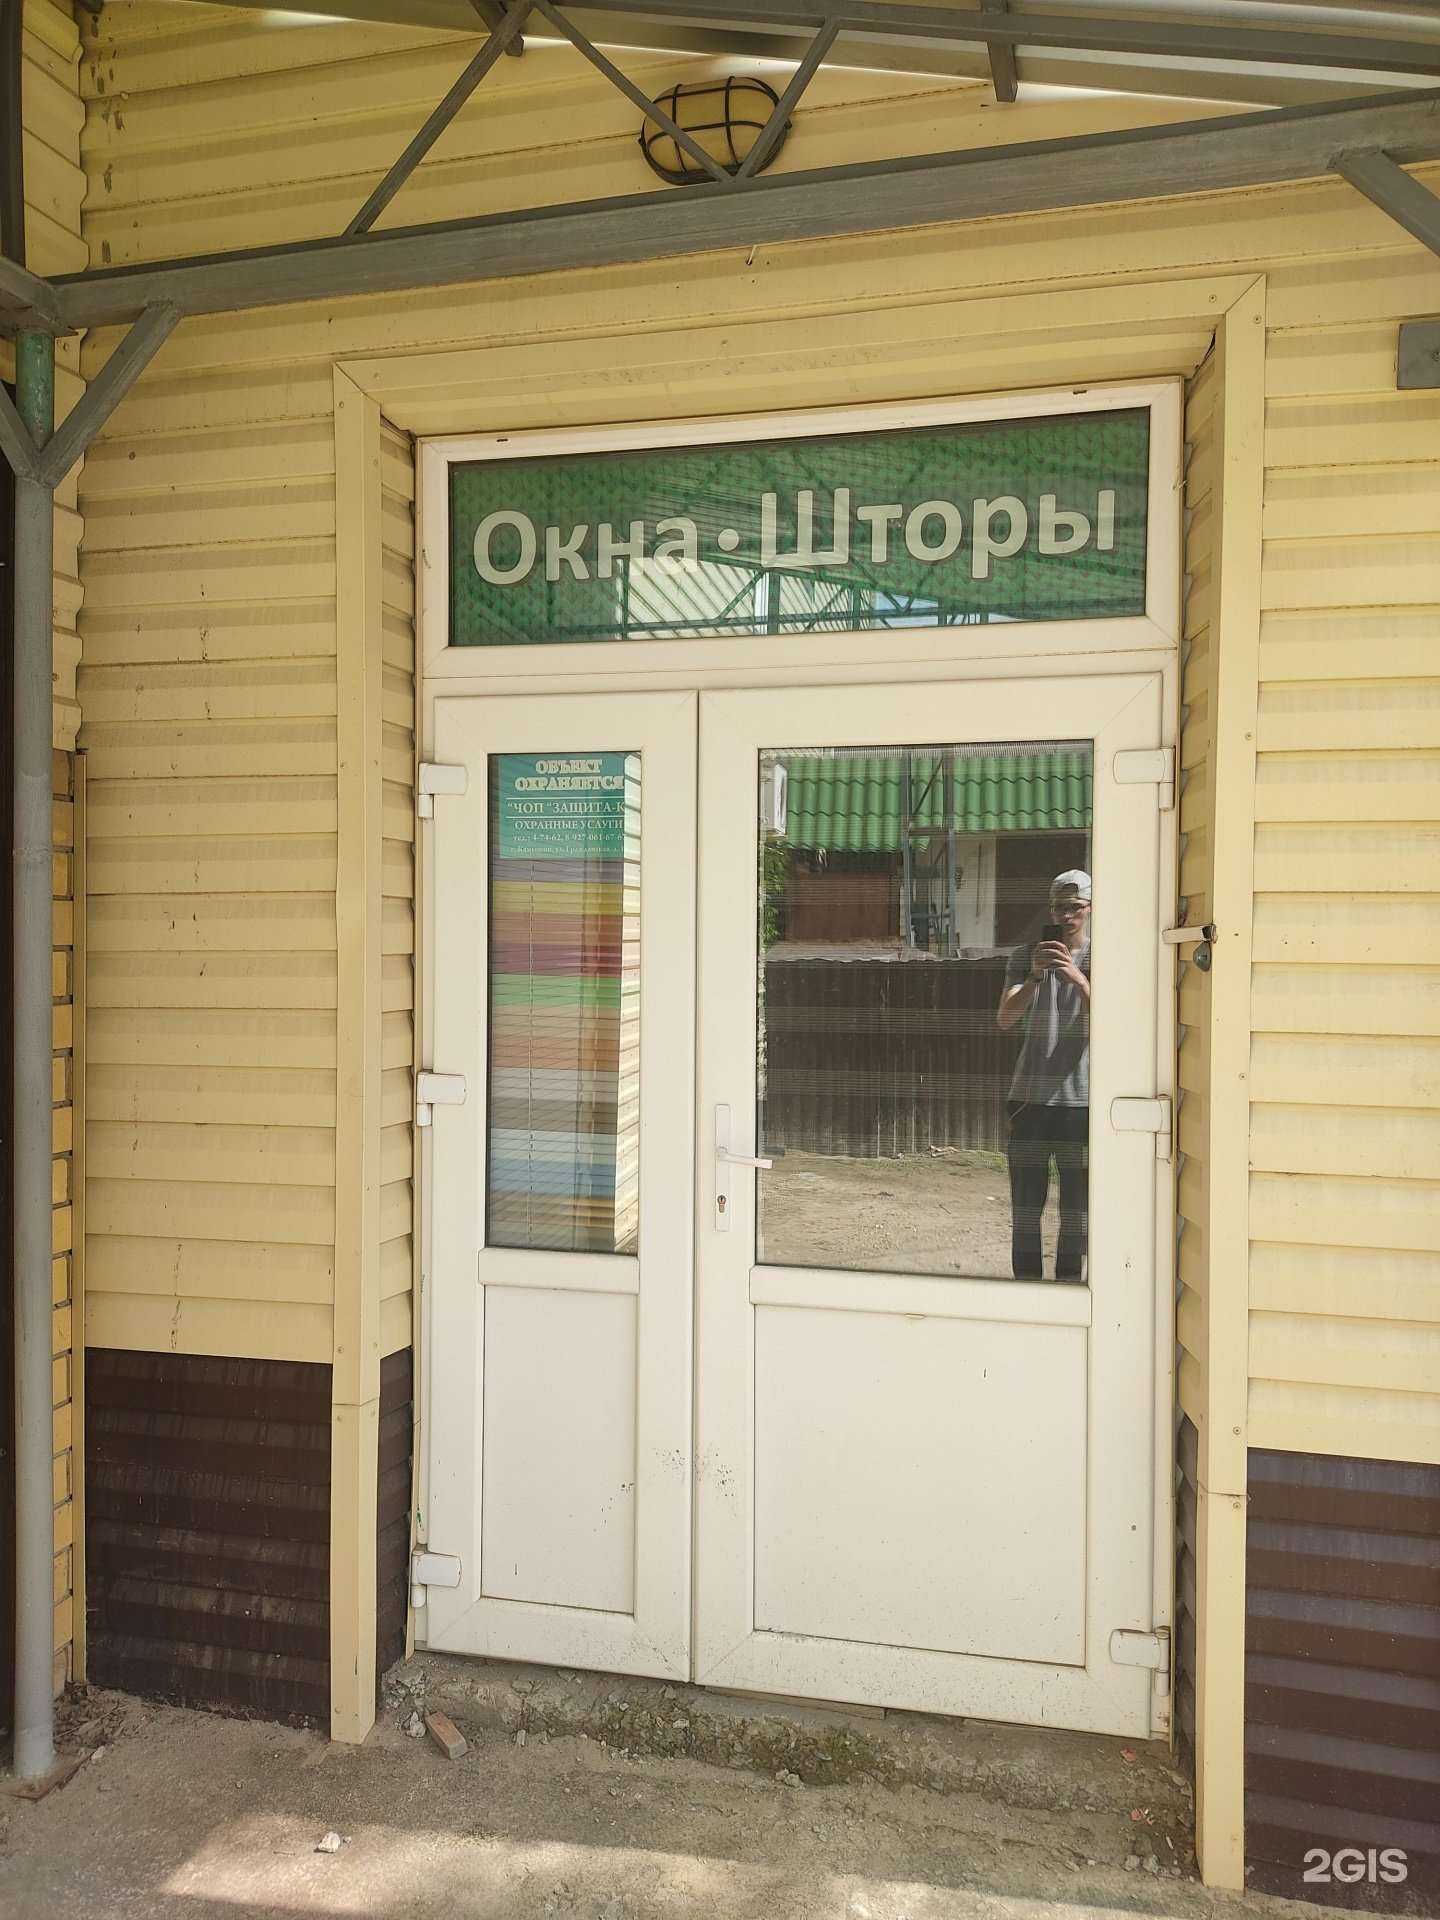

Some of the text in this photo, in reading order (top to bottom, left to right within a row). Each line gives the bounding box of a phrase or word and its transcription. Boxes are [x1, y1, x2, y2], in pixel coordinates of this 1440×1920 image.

[472, 487, 1115, 586] Окна Шторы
[535, 759, 602, 774] ОБЪЕКТ
[514, 775, 625, 791] ОХРАНЯЕТСЯ
[514, 819, 624, 830] ОХРАННЫЕ УСЛУГИ
